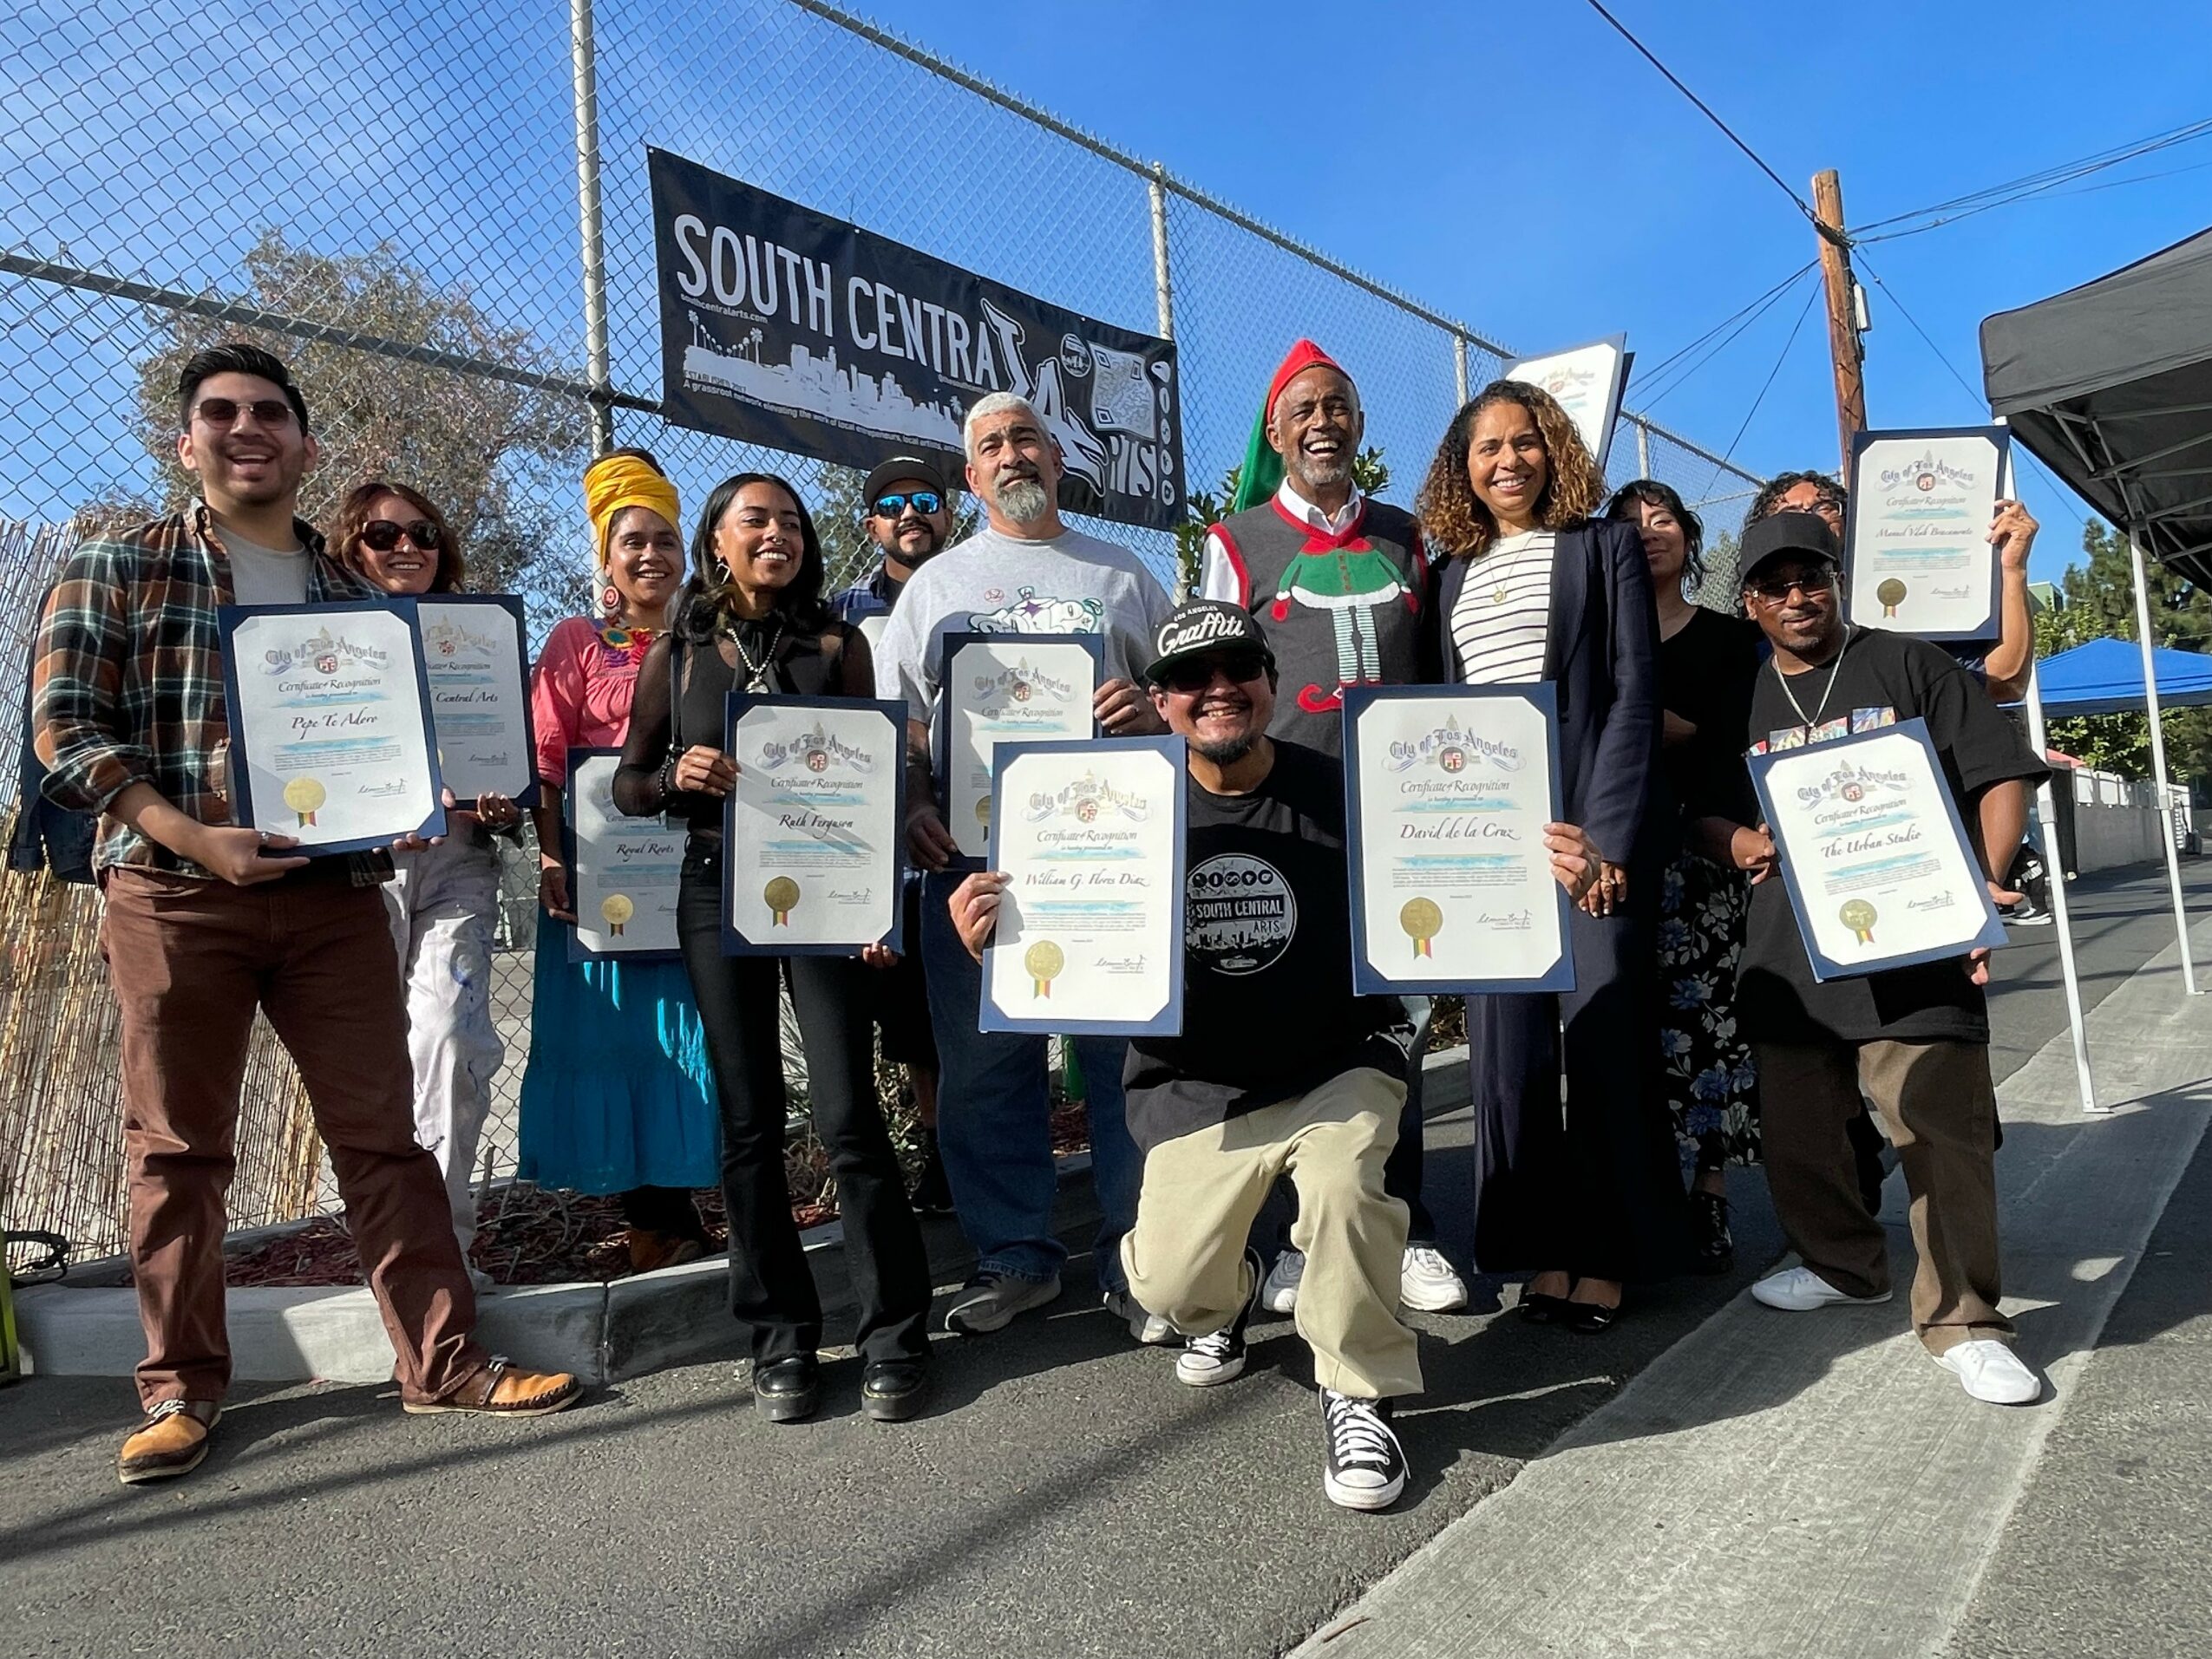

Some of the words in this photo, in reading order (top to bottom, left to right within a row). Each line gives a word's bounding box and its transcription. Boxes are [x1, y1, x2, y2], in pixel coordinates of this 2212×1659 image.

[674, 213, 834, 337] SOUTH
[680, 293, 769, 324] southcentralarts.com
[683, 379, 690, 389] A
[691, 382, 732, 398] grassroot
[763, 403, 798, 418] elevating
[799, 409, 812, 419] the
[838, 421, 855, 431] local
[902, 435, 919, 446] local
[1881, 470, 1901, 483] City
[1903, 465, 1913, 478] of
[1934, 460, 1973, 480] Angeles
[1175, 612, 1186, 622] LOS
[1188, 605, 1218, 615] ANGELES
[1157, 612, 1245, 657] Graffiti
[278, 680, 322, 694] Certificate
[330, 677, 381, 691] Recognition
[436, 687, 479, 702] Central
[475, 691, 498, 702] Arts
[291, 717, 318, 740] Pepe
[763, 742, 786, 759] City
[789, 738, 801, 754] of
[802, 734, 826, 749] Los
[827, 735, 872, 763] Angeles
[1390, 741, 1416, 759] City
[1420, 735, 1432, 752] of
[1432, 728, 1461, 746] Los
[1463, 727, 1518, 761] Angeles
[771, 778, 810, 792] Certificate
[817, 778, 863, 793] Recognition
[1401, 780, 1448, 798] Certificate
[1454, 780, 1509, 796] Recognition
[1797, 787, 1821, 800] City
[1822, 778, 1831, 791] of
[1830, 771, 1855, 787] Los
[1857, 766, 1906, 784] Angeles
[1030, 793, 1054, 810] City
[1057, 787, 1070, 803] of
[1070, 781, 1097, 797] Los
[1097, 780, 1147, 810] Angeles
[1037, 829, 1079, 846] Certificate
[1087, 830, 1137, 846] Recognition
[1401, 817, 1450, 839] David
[1445, 817, 1463, 839] de
[1464, 817, 1478, 838] la
[1483, 823, 1522, 840] Cruz
[617, 838, 651, 862] Royal
[1821, 838, 1842, 858] The
[1847, 833, 1882, 853] Urban
[1886, 824, 1921, 846] Studio
[1025, 869, 1066, 885] William
[1070, 874, 1083, 890] G.
[1120, 874, 1150, 886] Diaz
[1196, 903, 1231, 918] SOUTH
[1235, 899, 1283, 916] CENTRAL
[1254, 920, 1279, 933] ARTS
